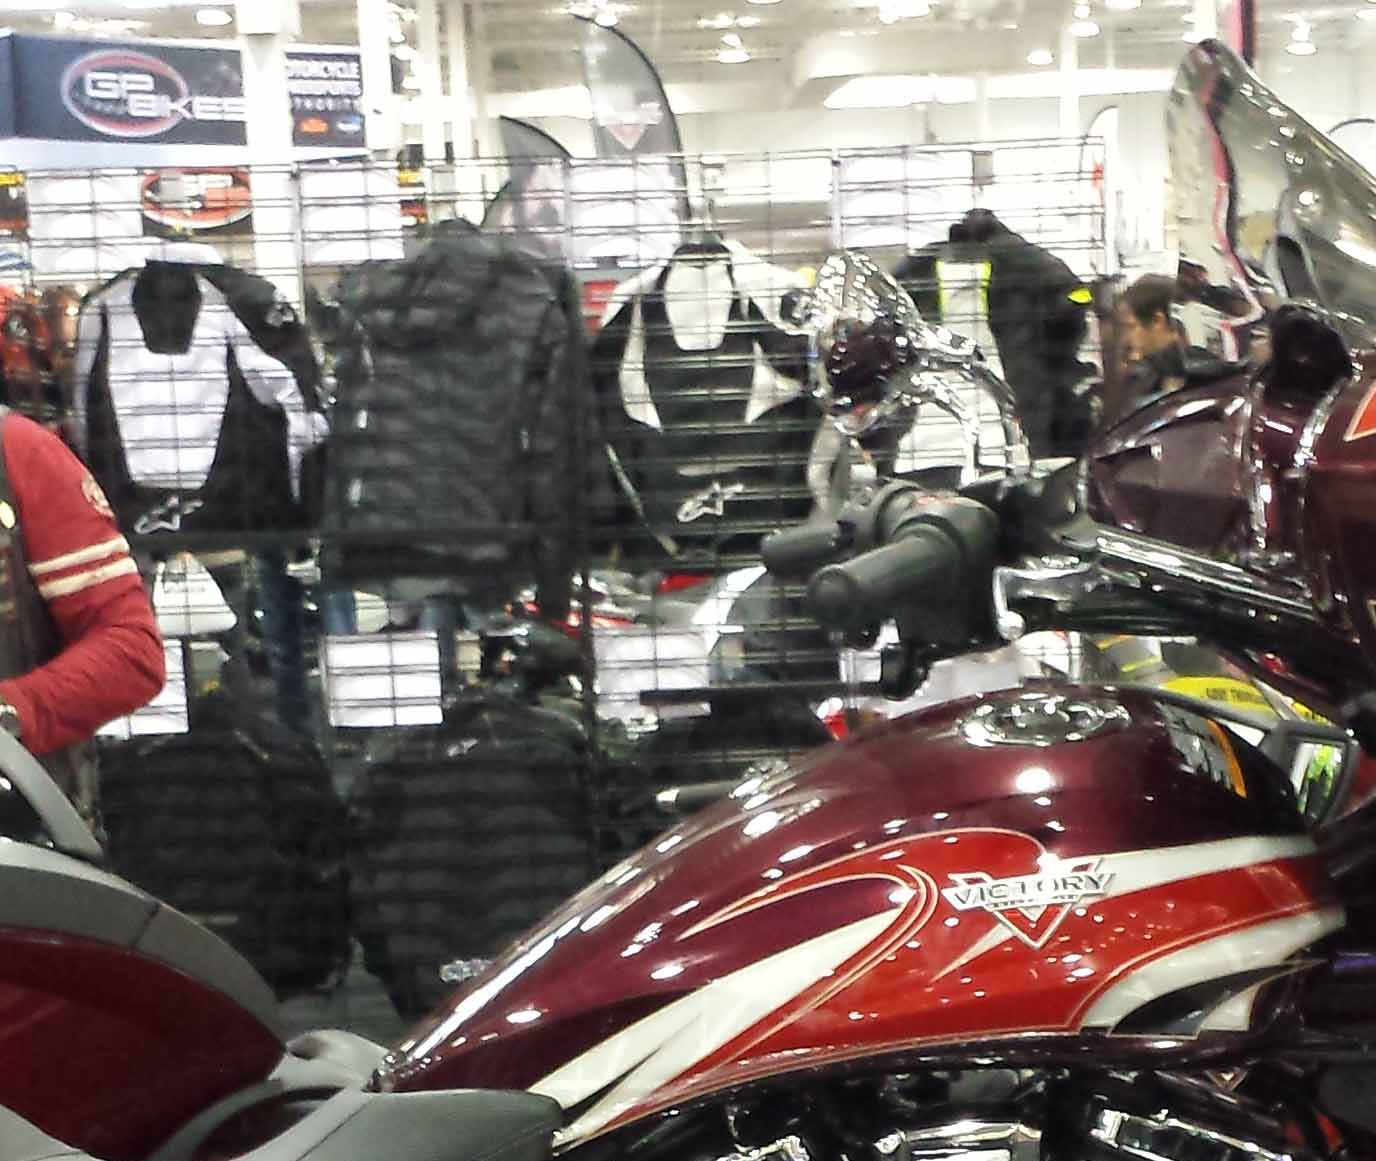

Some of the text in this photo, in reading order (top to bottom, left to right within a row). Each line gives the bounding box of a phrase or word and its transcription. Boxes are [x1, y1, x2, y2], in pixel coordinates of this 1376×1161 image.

[286, 59, 361, 79] OTORCYCLE
[83, 70, 155, 100] GP
[954, 870, 1117, 906] VICTORY
